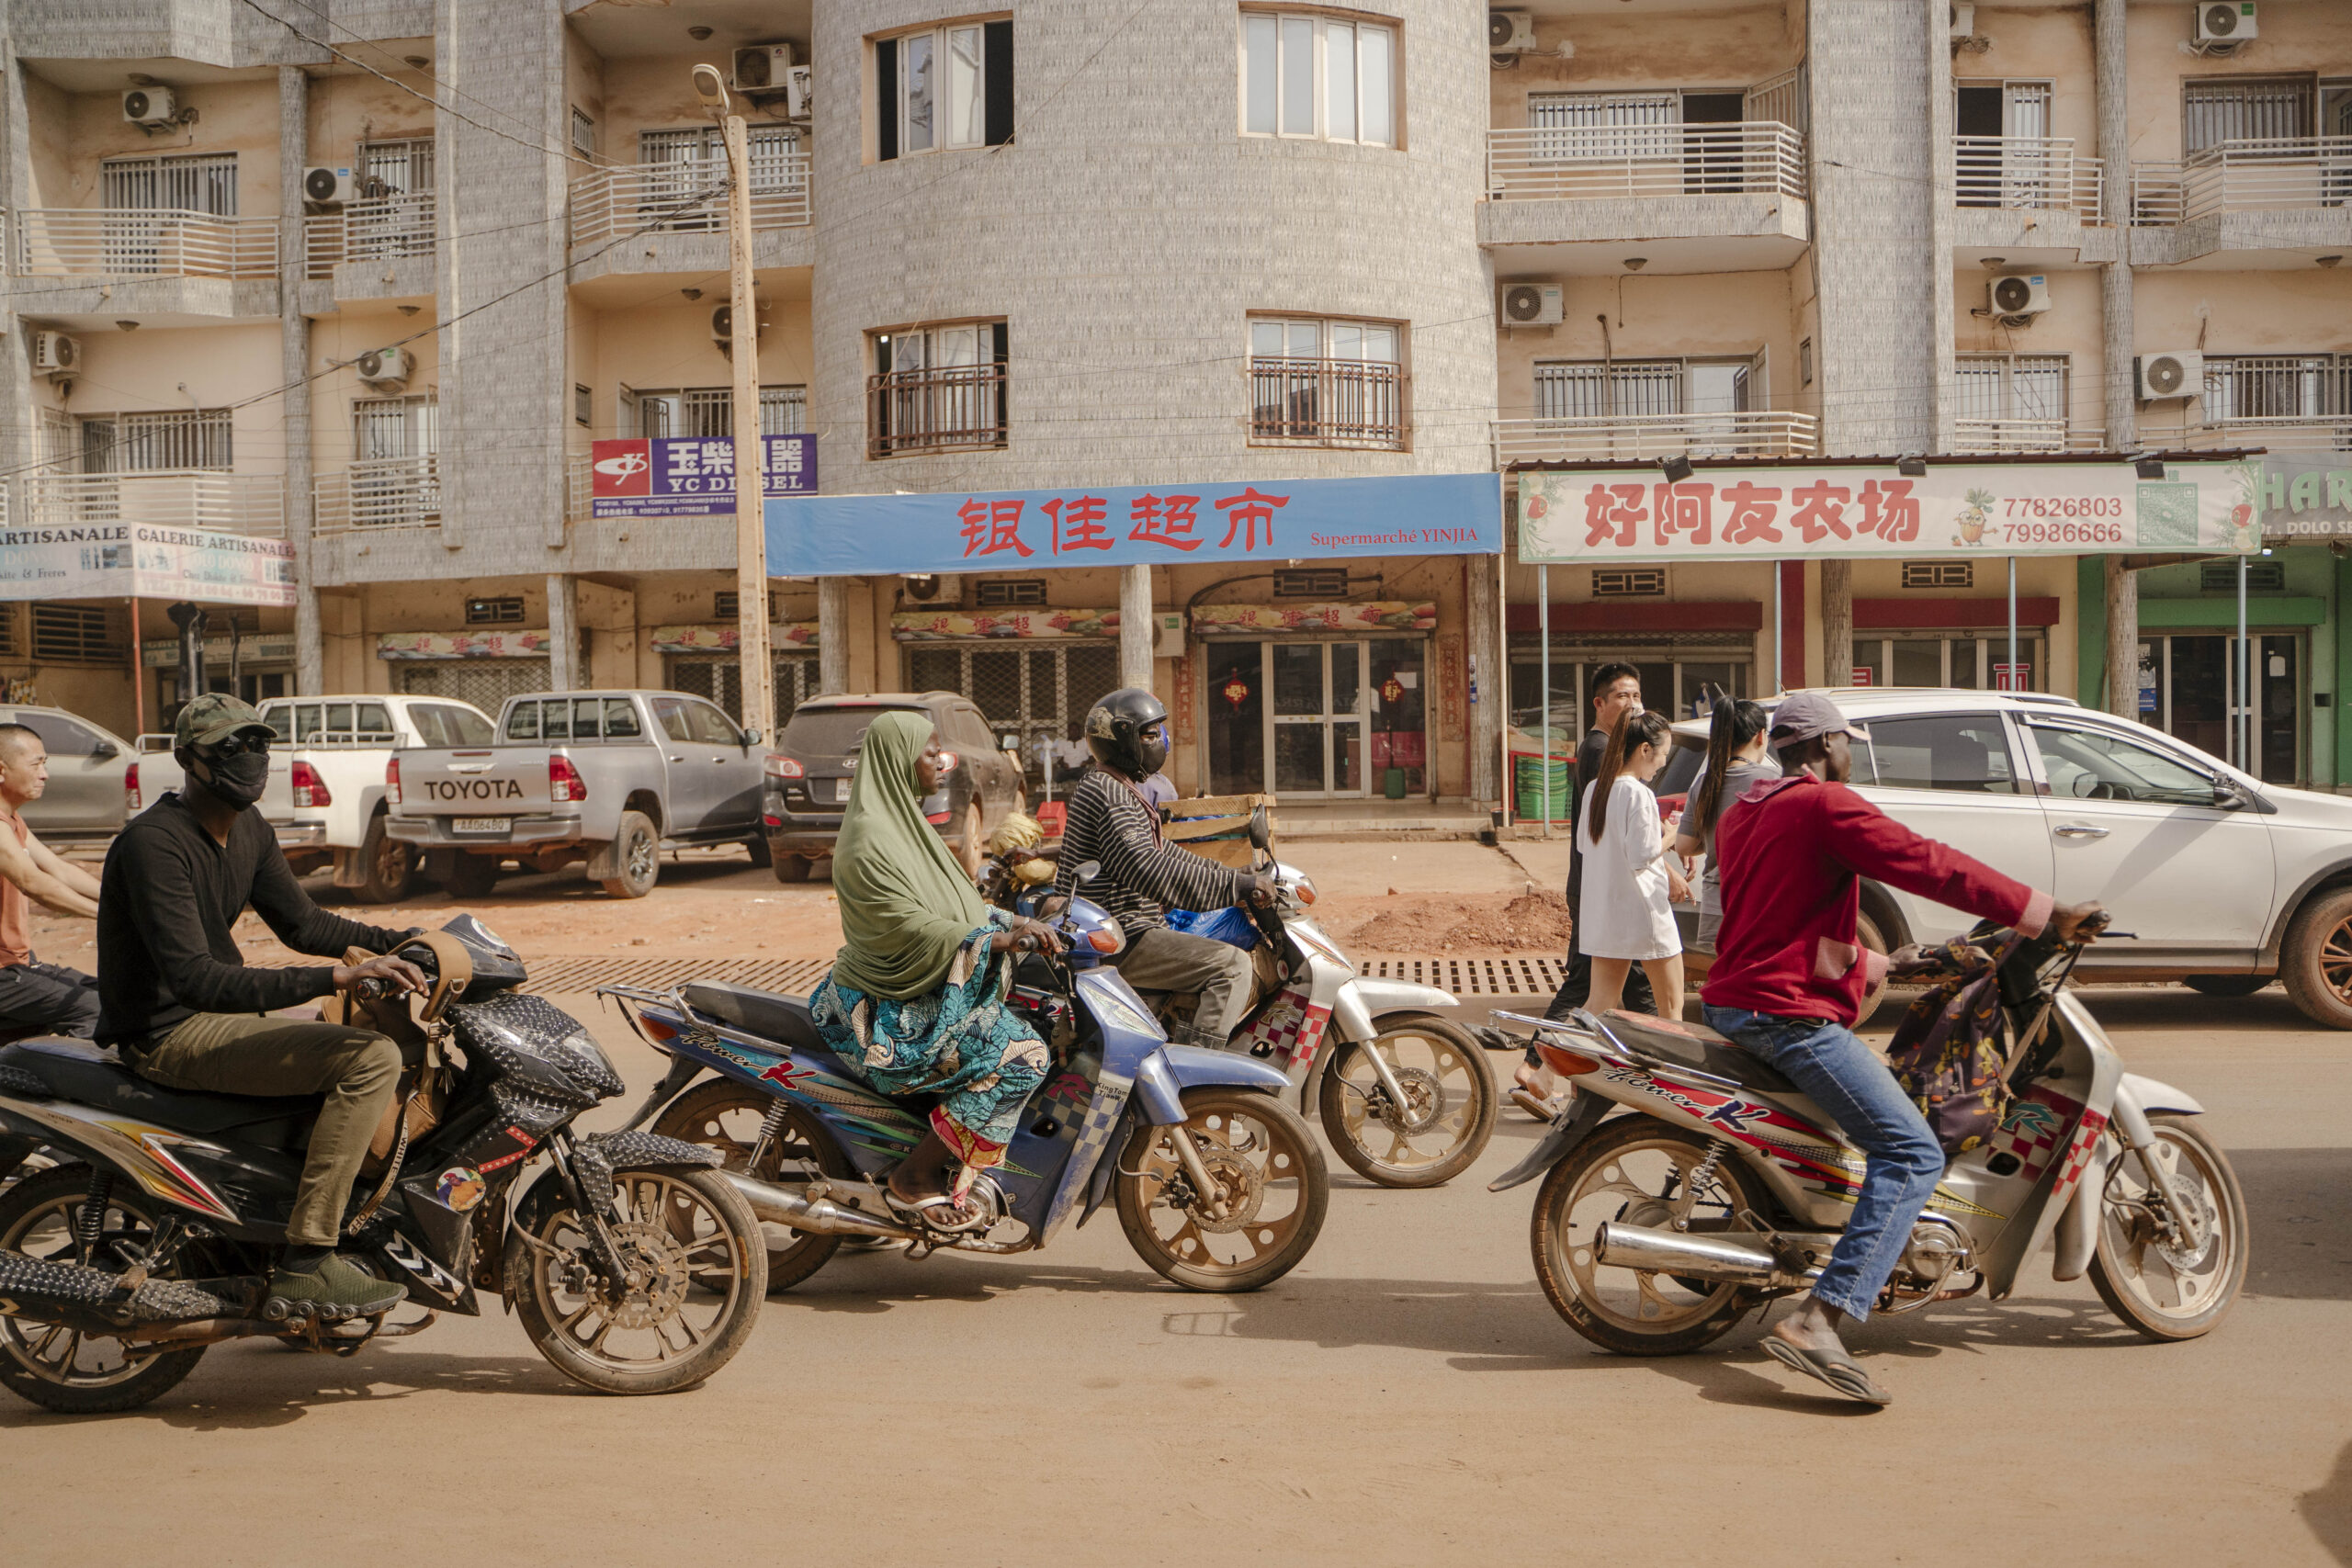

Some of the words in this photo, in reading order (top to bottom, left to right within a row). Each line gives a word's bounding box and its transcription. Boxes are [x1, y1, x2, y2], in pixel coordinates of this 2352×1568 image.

[667, 438, 803, 476] 玉柴器
[668, 479, 700, 492] YC
[708, 475, 804, 491] DISEL
[1584, 479, 1921, 547] 好阿友农场
[2003, 498, 2122, 517] 77826803
[956, 486, 1291, 558] 银佳超市
[2003, 523, 2122, 543] 79986666
[2287, 521, 2332, 534] DOLO
[138, 528, 205, 547] GALERIE
[208, 536, 296, 558] ARTISANALE
[1311, 529, 1418, 549] Supermarché
[1421, 527, 1478, 545] YINJIA
[424, 779, 524, 801] TOYOTA
